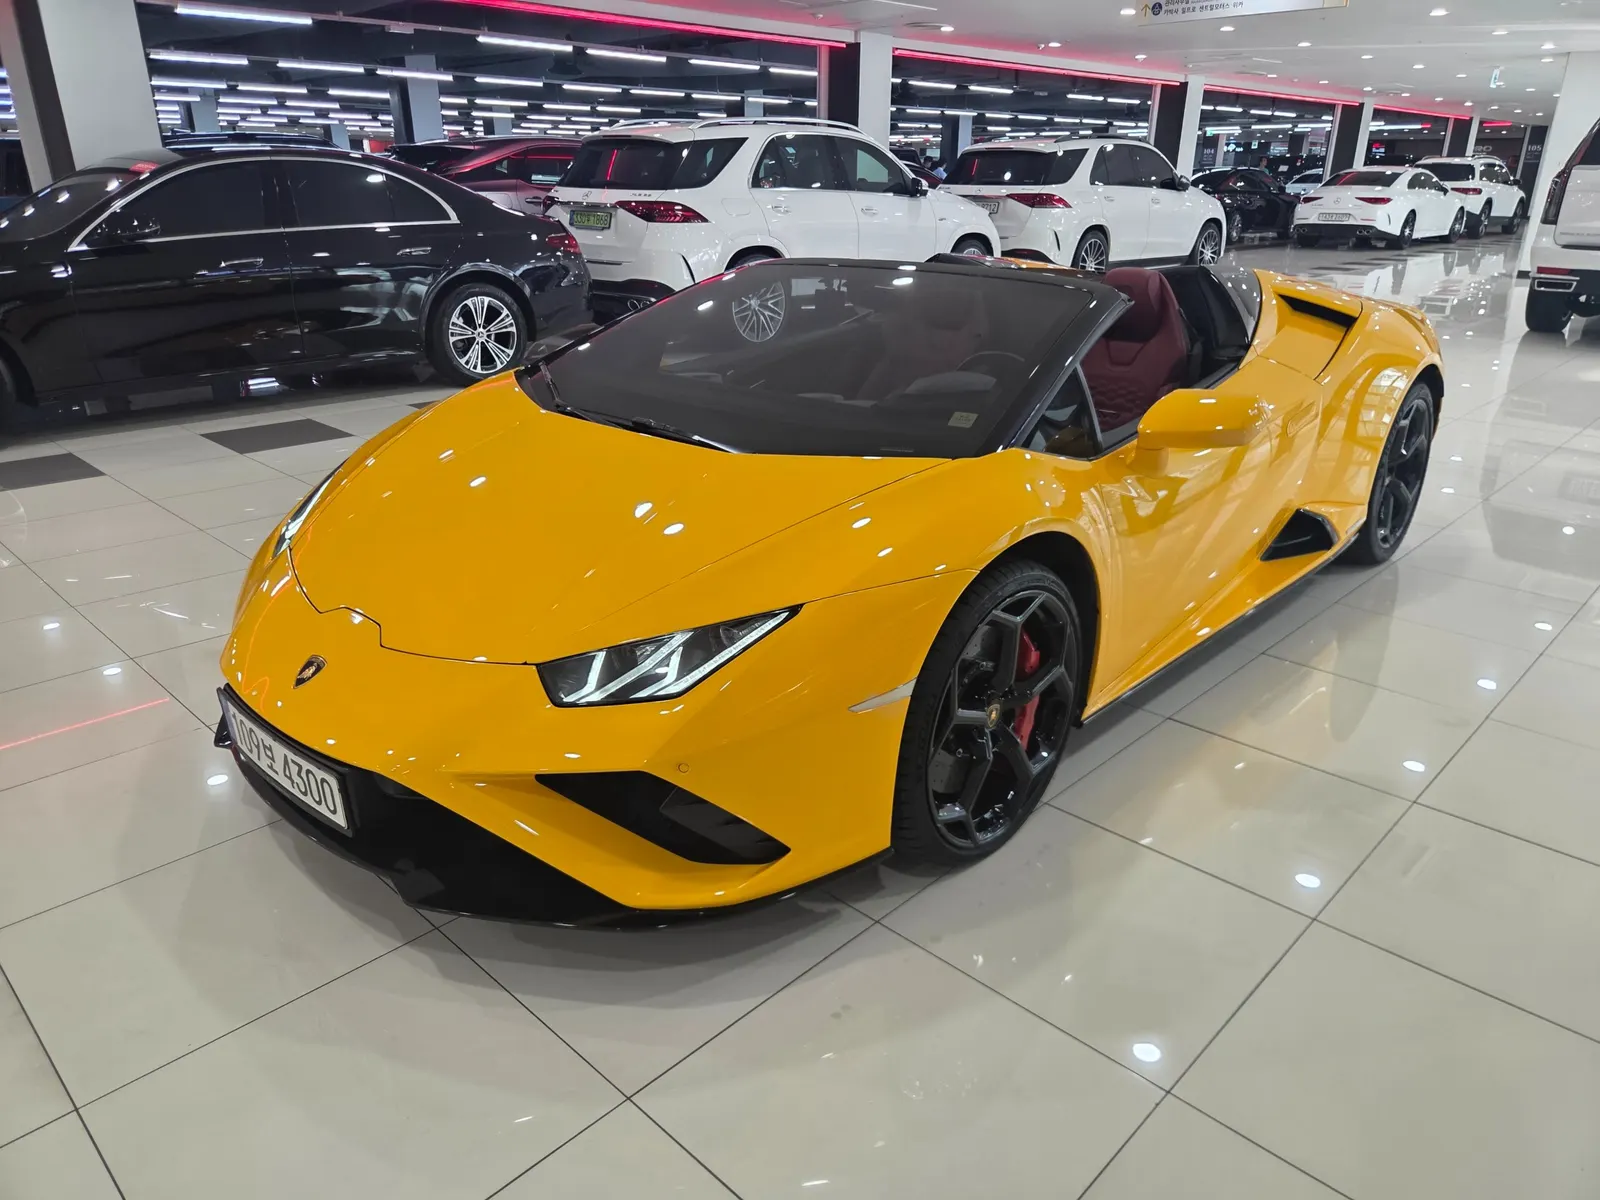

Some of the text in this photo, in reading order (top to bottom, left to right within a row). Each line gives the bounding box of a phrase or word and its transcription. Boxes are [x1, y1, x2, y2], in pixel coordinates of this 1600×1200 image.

[592, 213, 608, 226] 1868
[232, 712, 338, 816] 109보 4300
